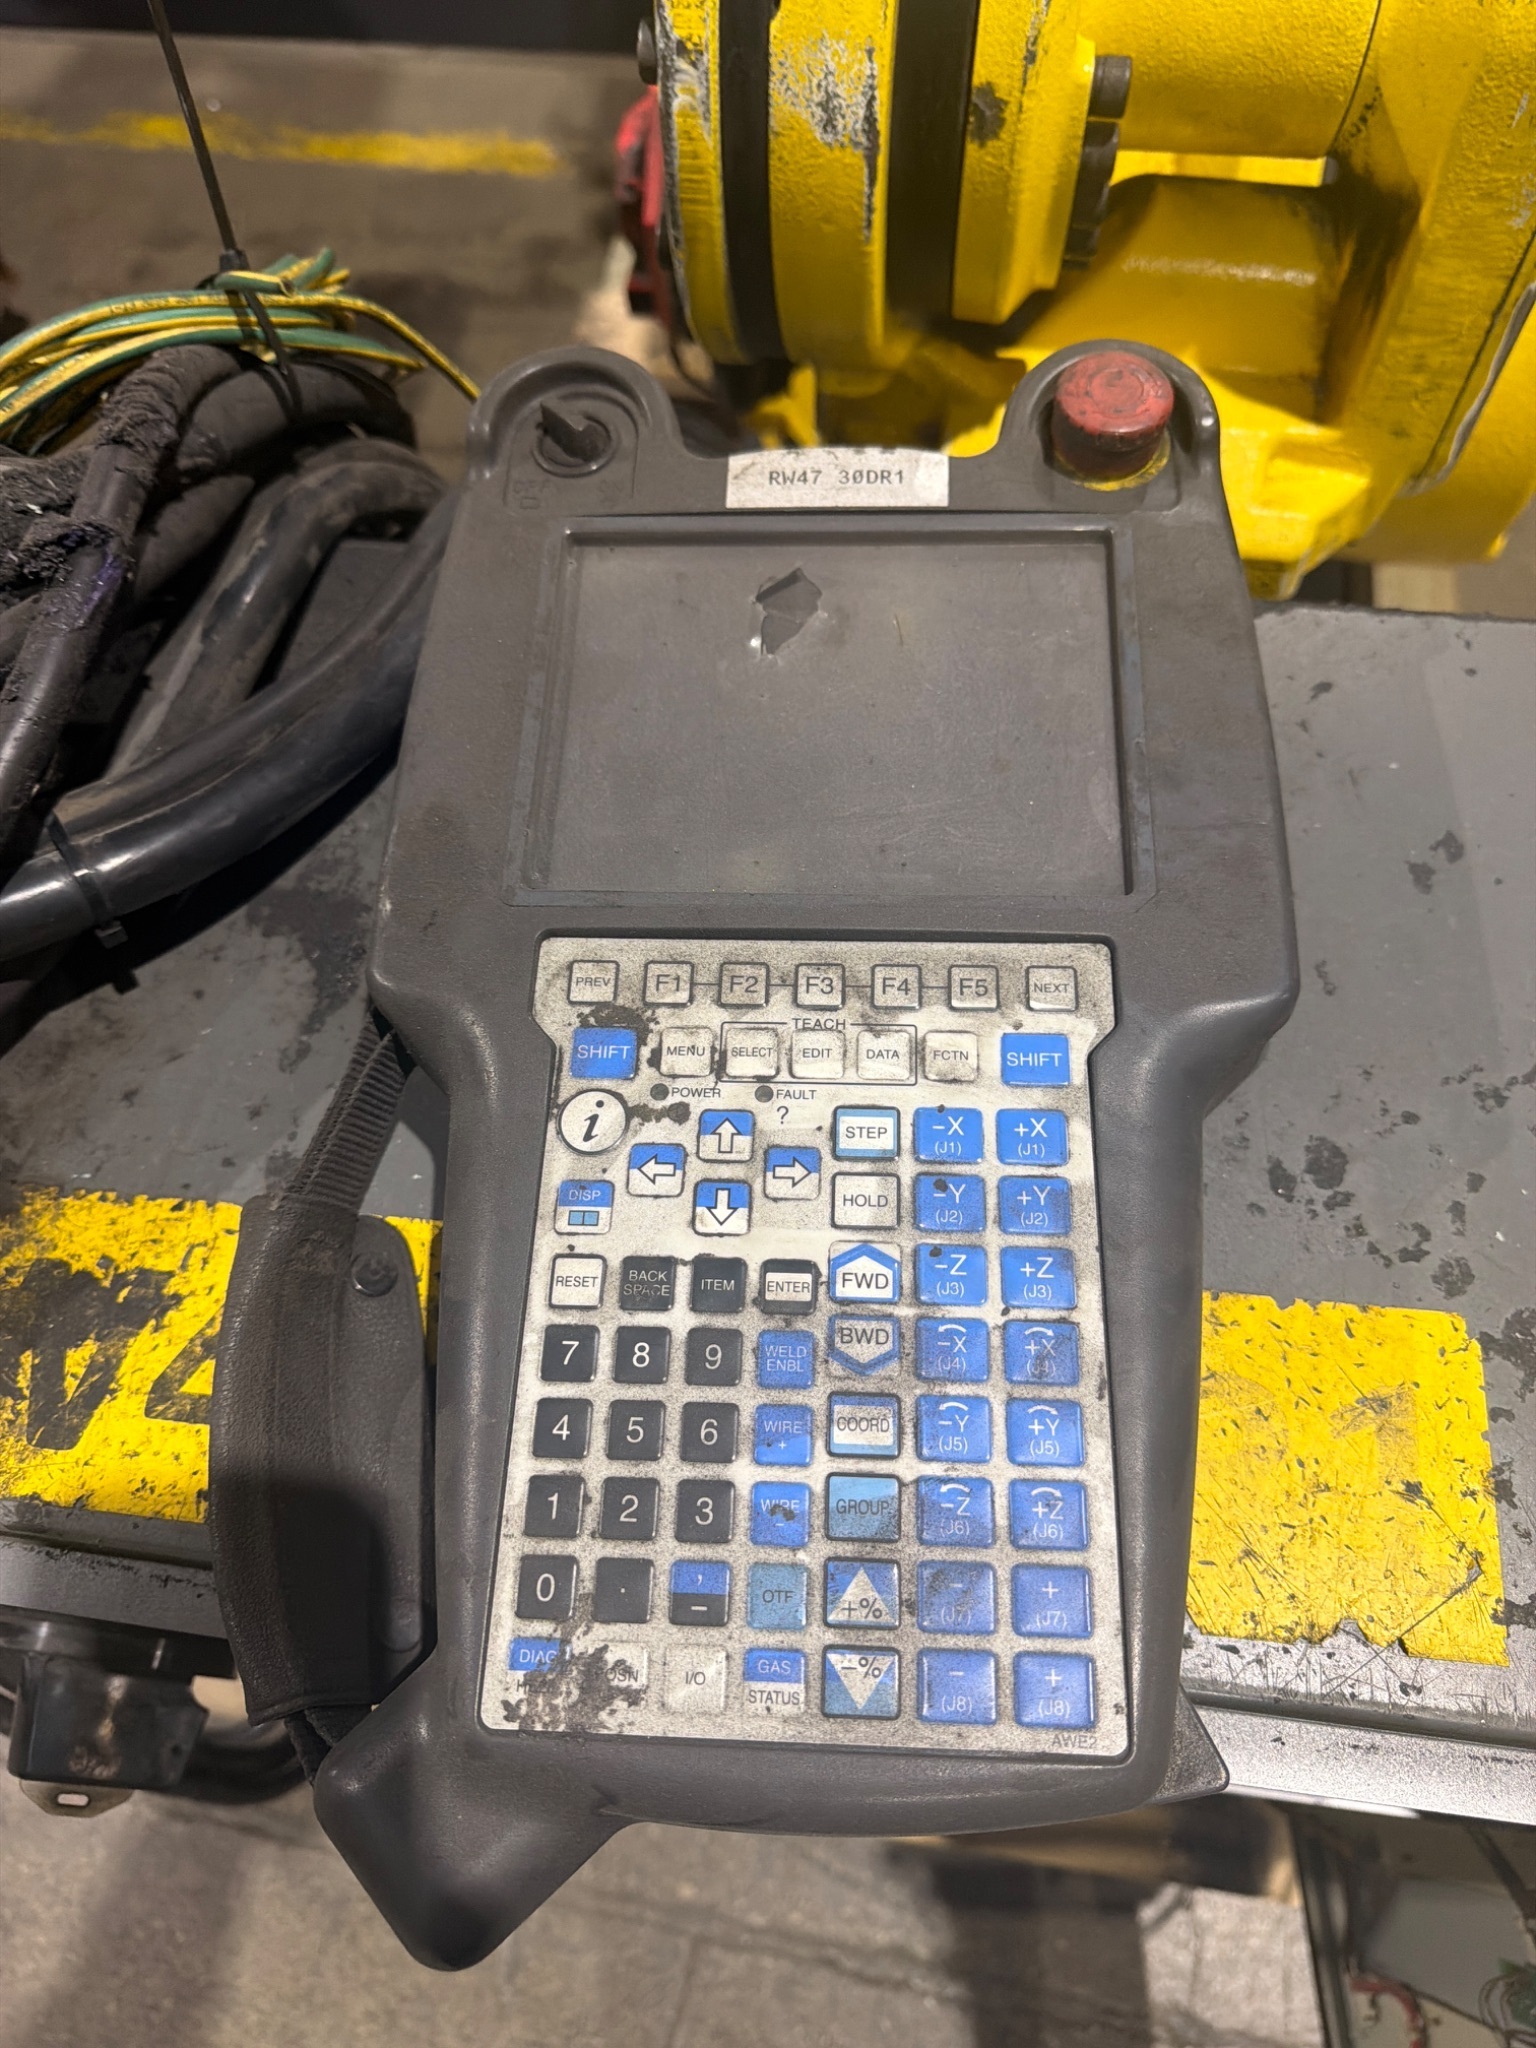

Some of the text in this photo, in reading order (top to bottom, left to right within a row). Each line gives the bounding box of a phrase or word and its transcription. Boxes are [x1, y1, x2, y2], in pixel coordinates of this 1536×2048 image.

[768, 470, 822, 486] RW47
[575, 976, 611, 987] PREV
[656, 974, 681, 992] F1
[729, 976, 758, 993] F2
[806, 977, 834, 994] F3
[882, 977, 911, 996] F4
[959, 978, 988, 996] F5
[1034, 982, 1069, 993] NEXT
[792, 1018, 846, 1030] TEACH
[577, 1045, 631, 1059] SHIFT
[666, 1046, 705, 1057] MENU
[731, 1046, 773, 1058] SELECT
[802, 1048, 832, 1058] EDIT
[866, 1049, 900, 1060] DATA
[933, 1050, 969, 1061] FCTN
[1006, 1052, 1062, 1067] SHIFT
[671, 1087, 721, 1098] POWER
[776, 1089, 817, 1100] FAULT
[776, 1105, 789, 1124] ?
[845, 1126, 887, 1140] STEP
[1014, 1118, 1048, 1138] +X
[934, 1141, 962, 1157] (J1)
[1018, 1142, 1046, 1158] (J1)
[568, 1189, 601, 1201] DISP
[842, 1194, 888, 1208] HOLD
[1016, 1185, 1051, 1206] +Y
[935, 1210, 963, 1225] (J2)
[1021, 1212, 1049, 1227] (J2)
[1020, 1257, 1054, 1279] +Z
[555, 1275, 598, 1288] RESET
[629, 1270, 668, 1283] BACK
[701, 1278, 735, 1291] ITEM
[841, 1272, 889, 1290] FWD
[623, 1284, 670, 1297] SPACE
[767, 1281, 811, 1294] ENTER
[936, 1281, 964, 1297] (J3)
[1023, 1284, 1052, 1300] (J3)
[840, 1328, 889, 1345] BWD
[561, 1340, 580, 1366] 7
[632, 1342, 650, 1368] 8
[704, 1343, 722, 1370] 9
[765, 1346, 807, 1358] WELD
[767, 1359, 804, 1372] ENBL
[937, 1356, 966, 1372] (J4)
[552, 1414, 571, 1441] 4
[626, 1416, 644, 1443] 5
[700, 1419, 718, 1446] 6
[764, 1420, 803, 1433] WIRE
[836, 1417, 890, 1433] COORD
[1028, 1418, 1060, 1436] +Y
[938, 1436, 968, 1453] (J5)
[1029, 1440, 1060, 1457] (J5)
[547, 1492, 560, 1520] 1
[619, 1494, 639, 1522] 2
[695, 1497, 714, 1525] 3
[836, 1499, 890, 1515] GROUP
[940, 1519, 970, 1536] (J6)
[1033, 1523, 1064, 1541] (J6)
[536, 1573, 555, 1602] 0
[762, 1589, 795, 1604] OTF
[1036, 1611, 1067, 1629] (J7)
[602, 1666, 639, 1683] OSN
[758, 1660, 791, 1674] GAS
[685, 1671, 706, 1686] I/O
[748, 1689, 800, 1705] STATUS
[941, 1696, 973, 1714] (J8)
[1039, 1700, 1071, 1718] (J8)
